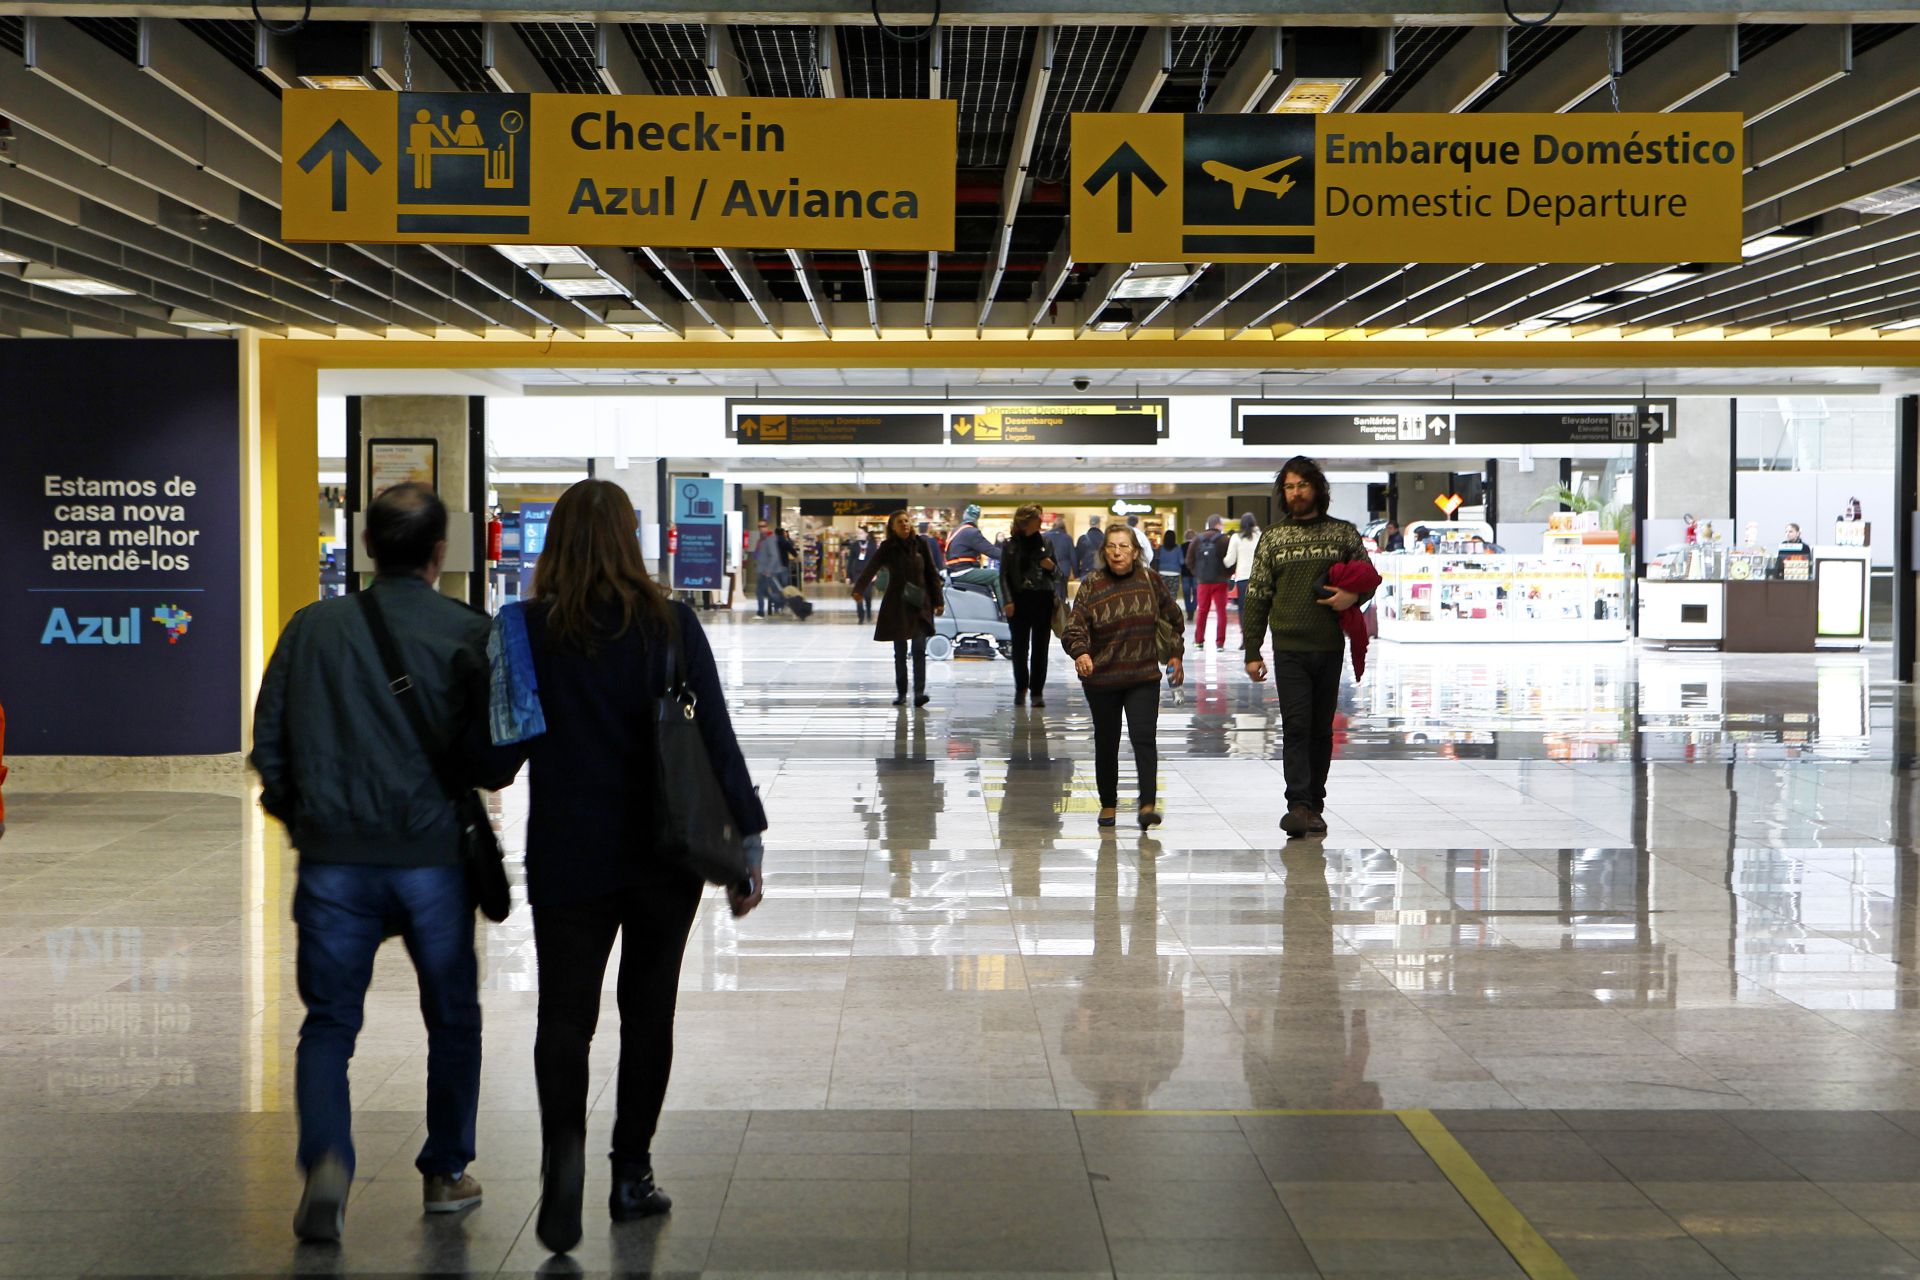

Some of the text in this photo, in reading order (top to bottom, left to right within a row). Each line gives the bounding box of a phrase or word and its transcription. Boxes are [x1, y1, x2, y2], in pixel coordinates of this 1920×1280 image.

[570, 110, 785, 152] Check-in
[1325, 130, 1736, 173] Embarque Doméstico
[567, 176, 919, 221] Azul / Avianca
[1326, 185, 1688, 226] Domestic Departure
[986, 405, 1034, 416] Domestic
[1005, 416, 1064, 427] Desembarque
[1353, 415, 1397, 426] Sanitários
[1561, 416, 1609, 425] Elevadores
[44, 475, 197, 497] Estamos de
[54, 504, 186, 522] casa nova
[43, 525, 200, 551] para melhor
[51, 549, 190, 571] atendê-los
[40, 607, 141, 645] Azul
